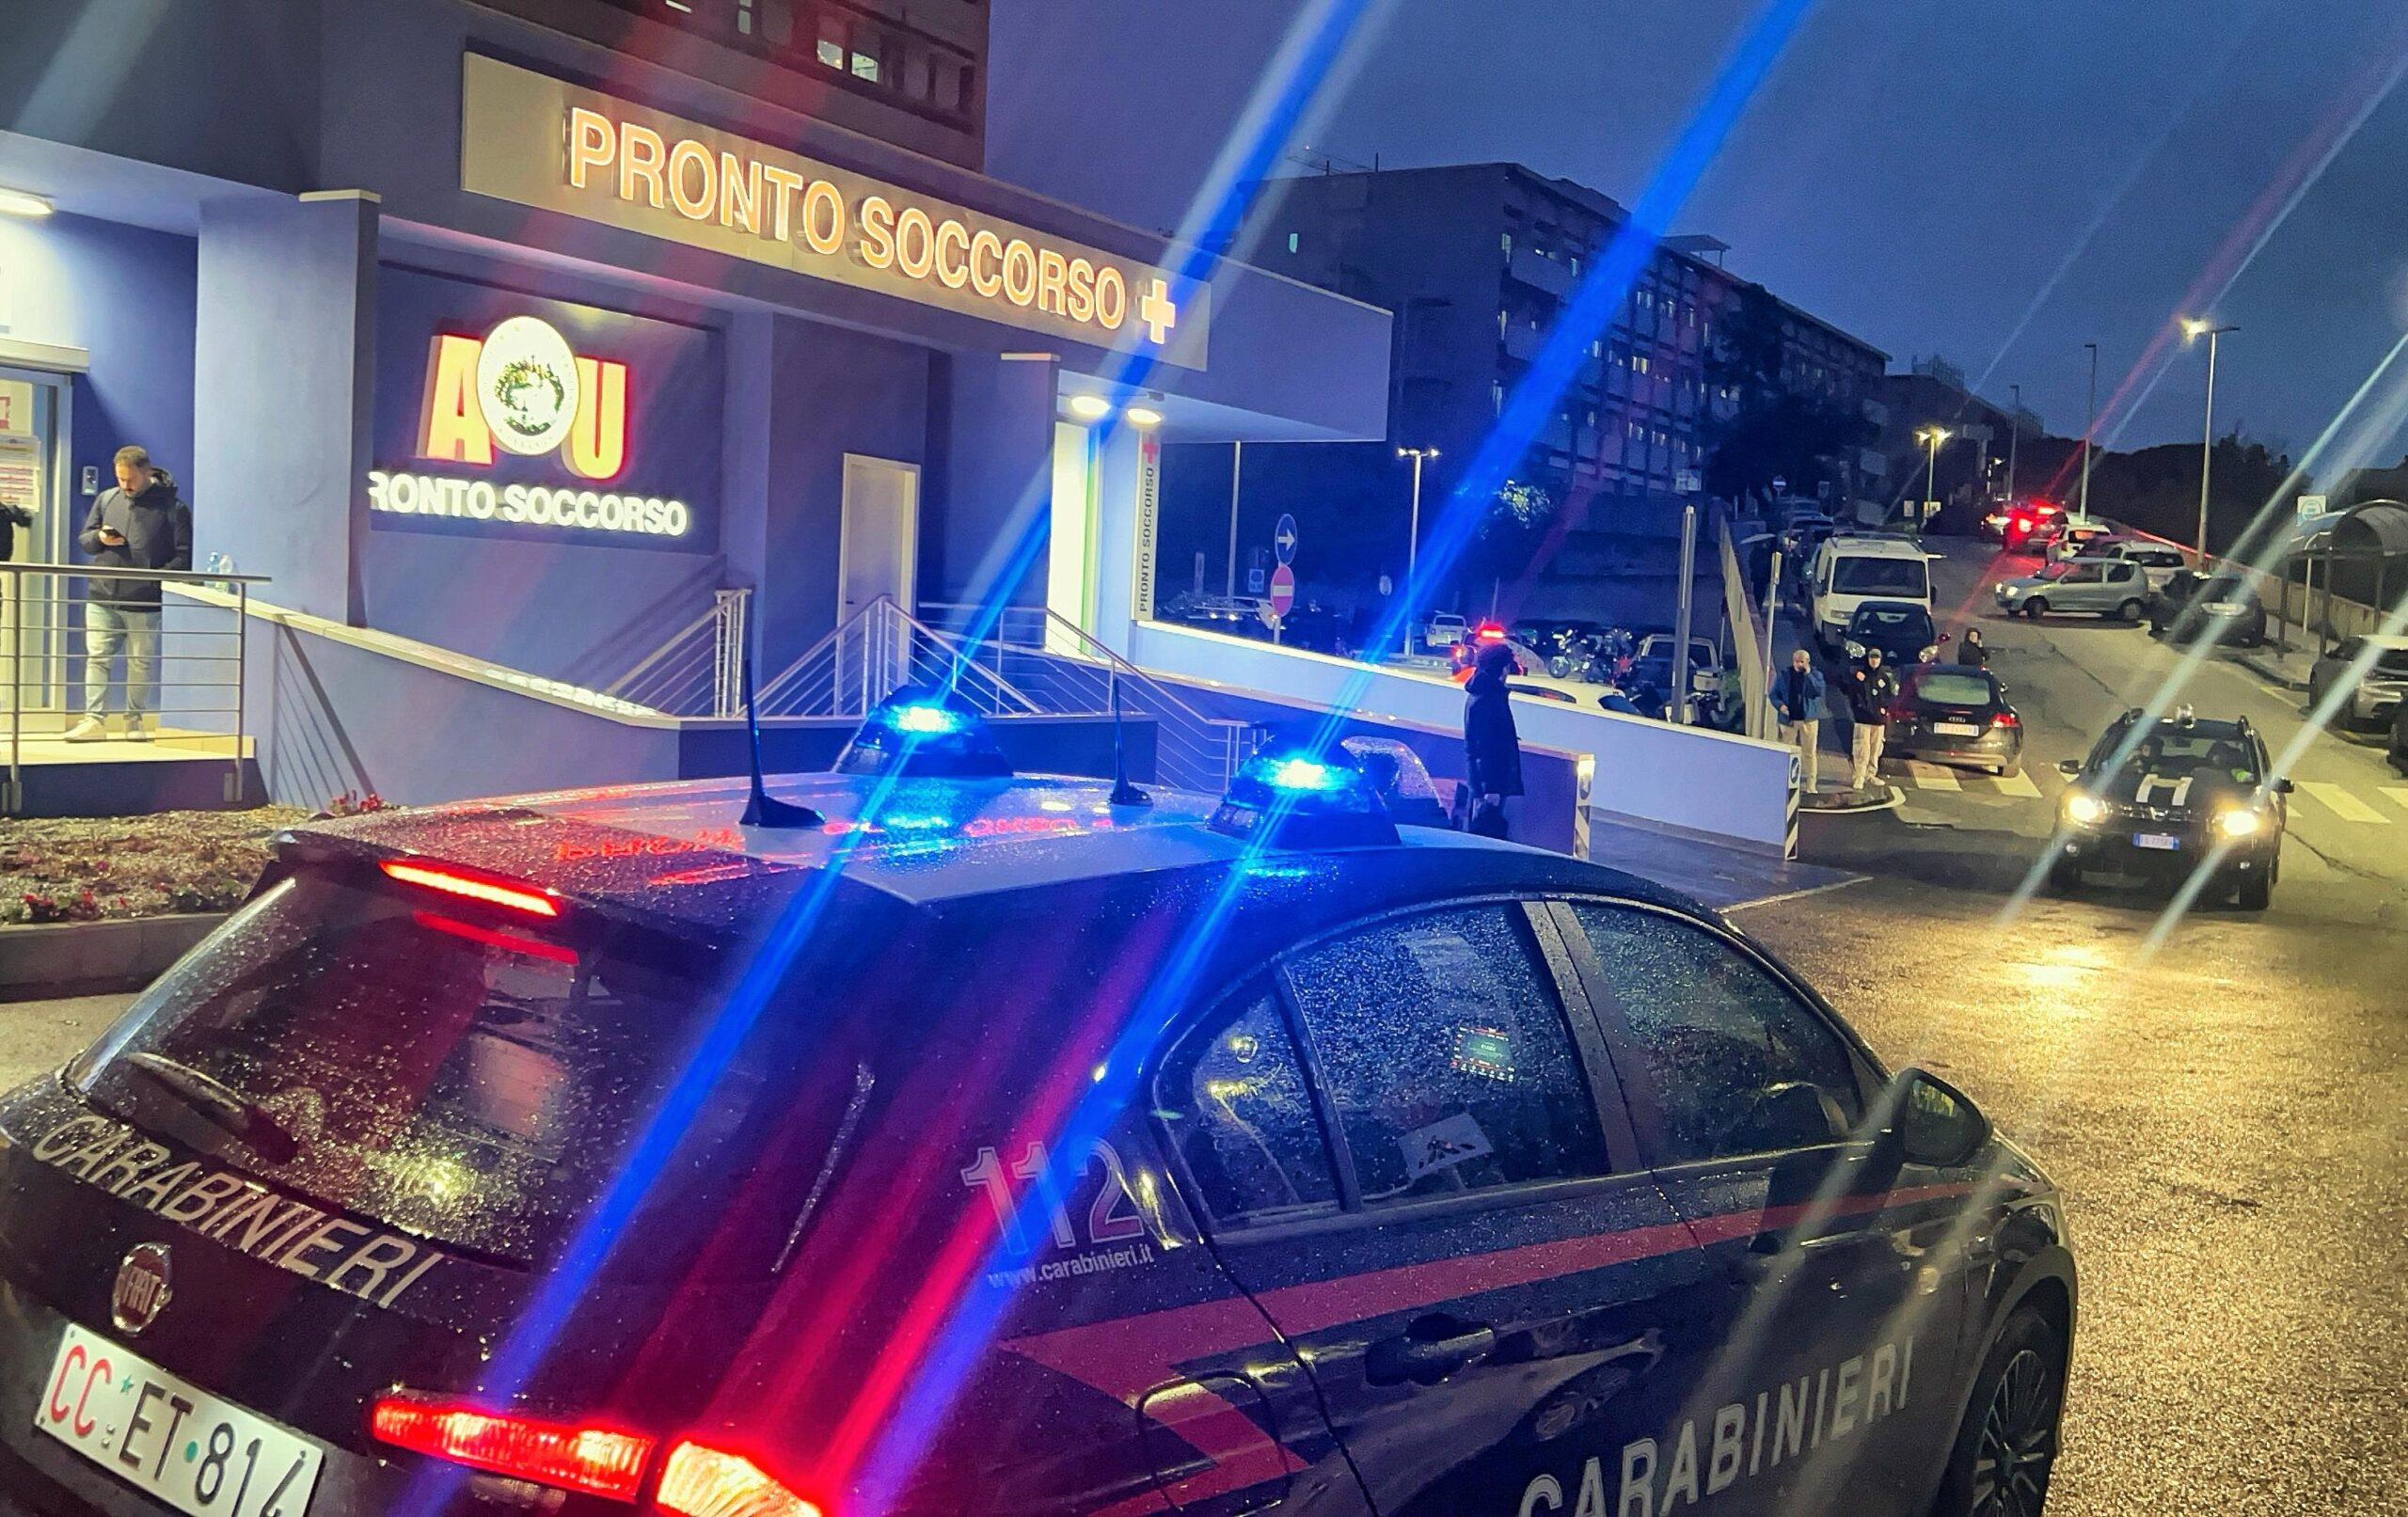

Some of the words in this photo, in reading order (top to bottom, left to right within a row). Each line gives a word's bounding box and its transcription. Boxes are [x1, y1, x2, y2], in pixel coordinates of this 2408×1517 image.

[569, 106, 845, 256] PRONTO
[860, 196, 1126, 330] SOCCORSO
[368, 471, 497, 519] RONTO
[503, 483, 688, 536] SOCCORSO
[1142, 467, 1154, 548] SOCCORSO
[1139, 552, 1150, 612] PRONTO
[33, 1115, 444, 1309] CARABINIERI
[959, 1136, 1146, 1256] 112
[121, 1265, 162, 1315] FIAT
[989, 1243, 1155, 1288] www.carabinieri.it
[50, 1344, 113, 1437] CC
[119, 1381, 196, 1481] ET
